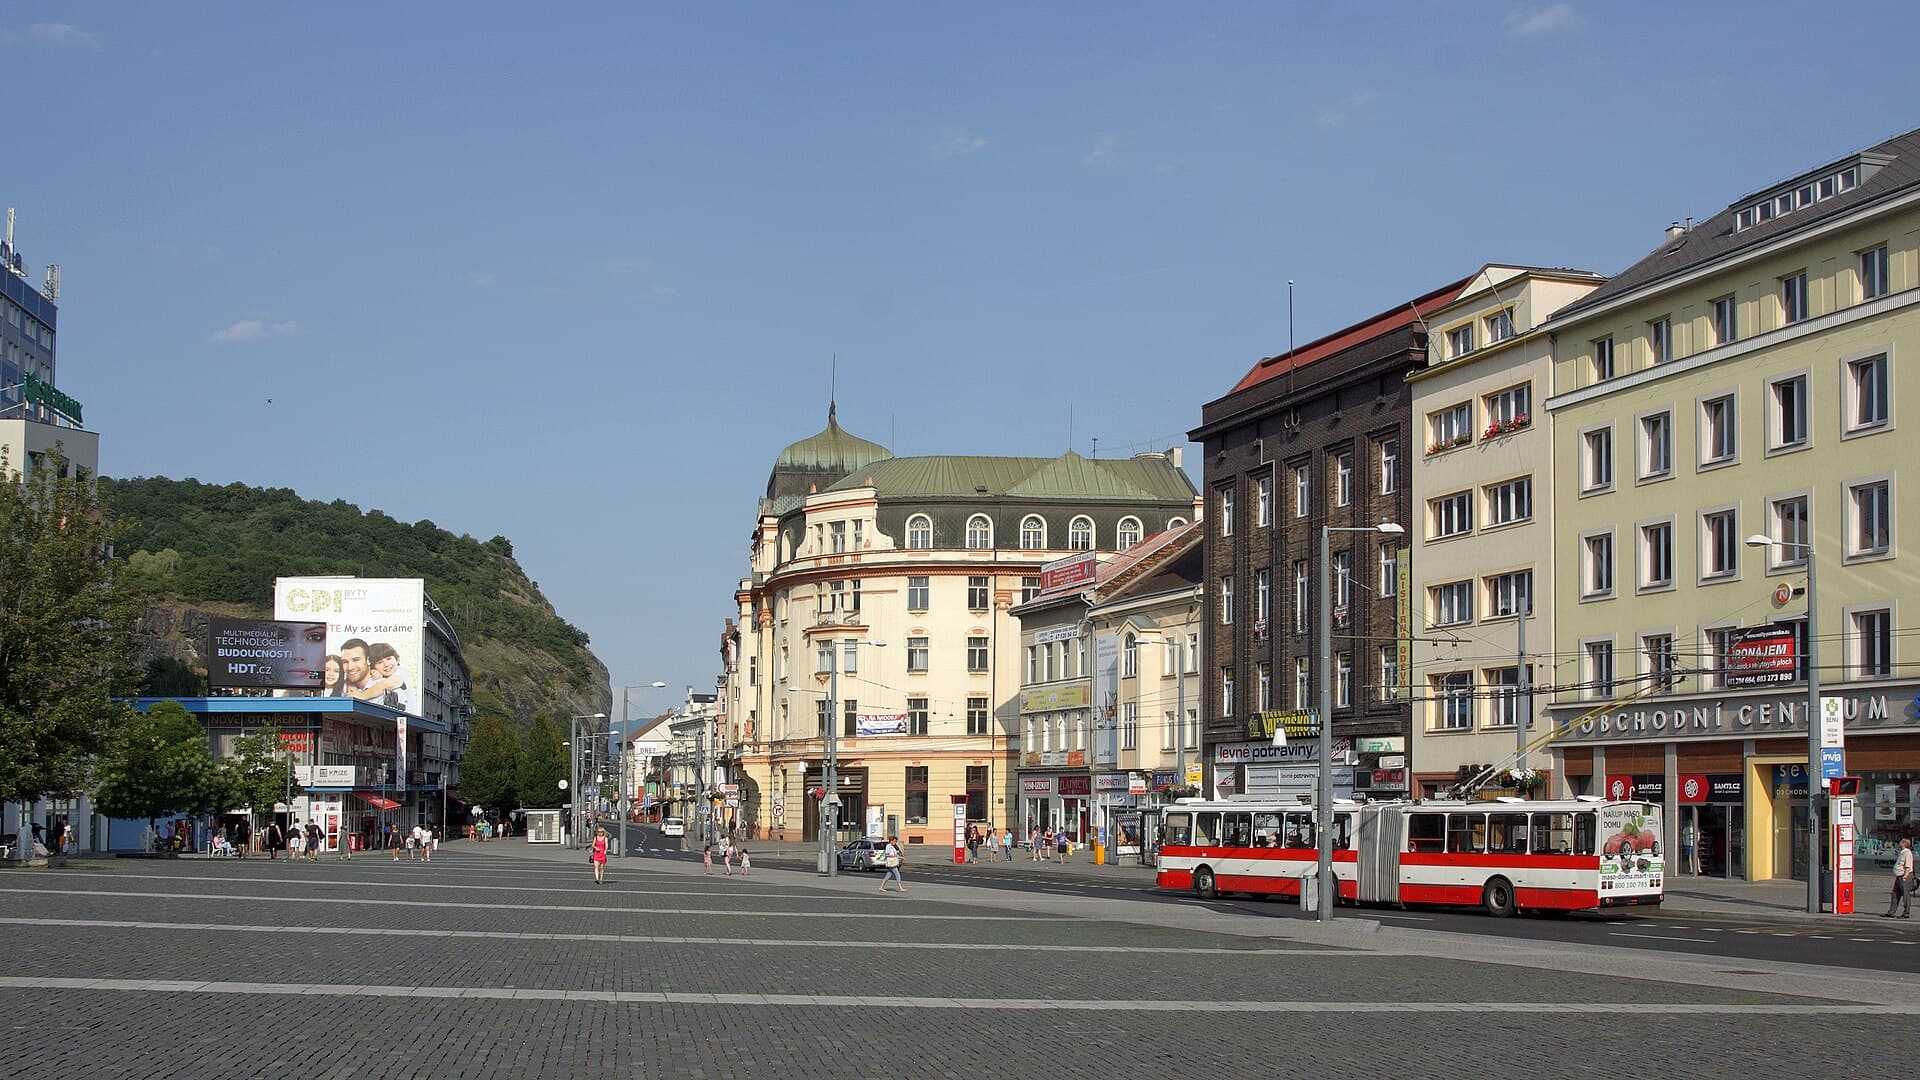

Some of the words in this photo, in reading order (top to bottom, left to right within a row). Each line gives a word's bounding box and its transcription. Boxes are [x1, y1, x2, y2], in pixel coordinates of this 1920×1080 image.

[344, 624, 358, 635] My
[374, 624, 413, 633] staráme
[215, 636, 285, 647] TECHNOLOGIE
[217, 648, 293, 658] BUDOUCNOSTI
[1731, 644, 1787, 659] RONÁJEM
[1581, 702, 1724, 734] OBCHODNÍ
[1738, 695, 1889, 726] CENTUM
[1219, 744, 1249, 759] levné
[1252, 743, 1314, 760] potraviny
[1623, 810, 1640, 818] MASO
[1603, 821, 1621, 829] DOMU
